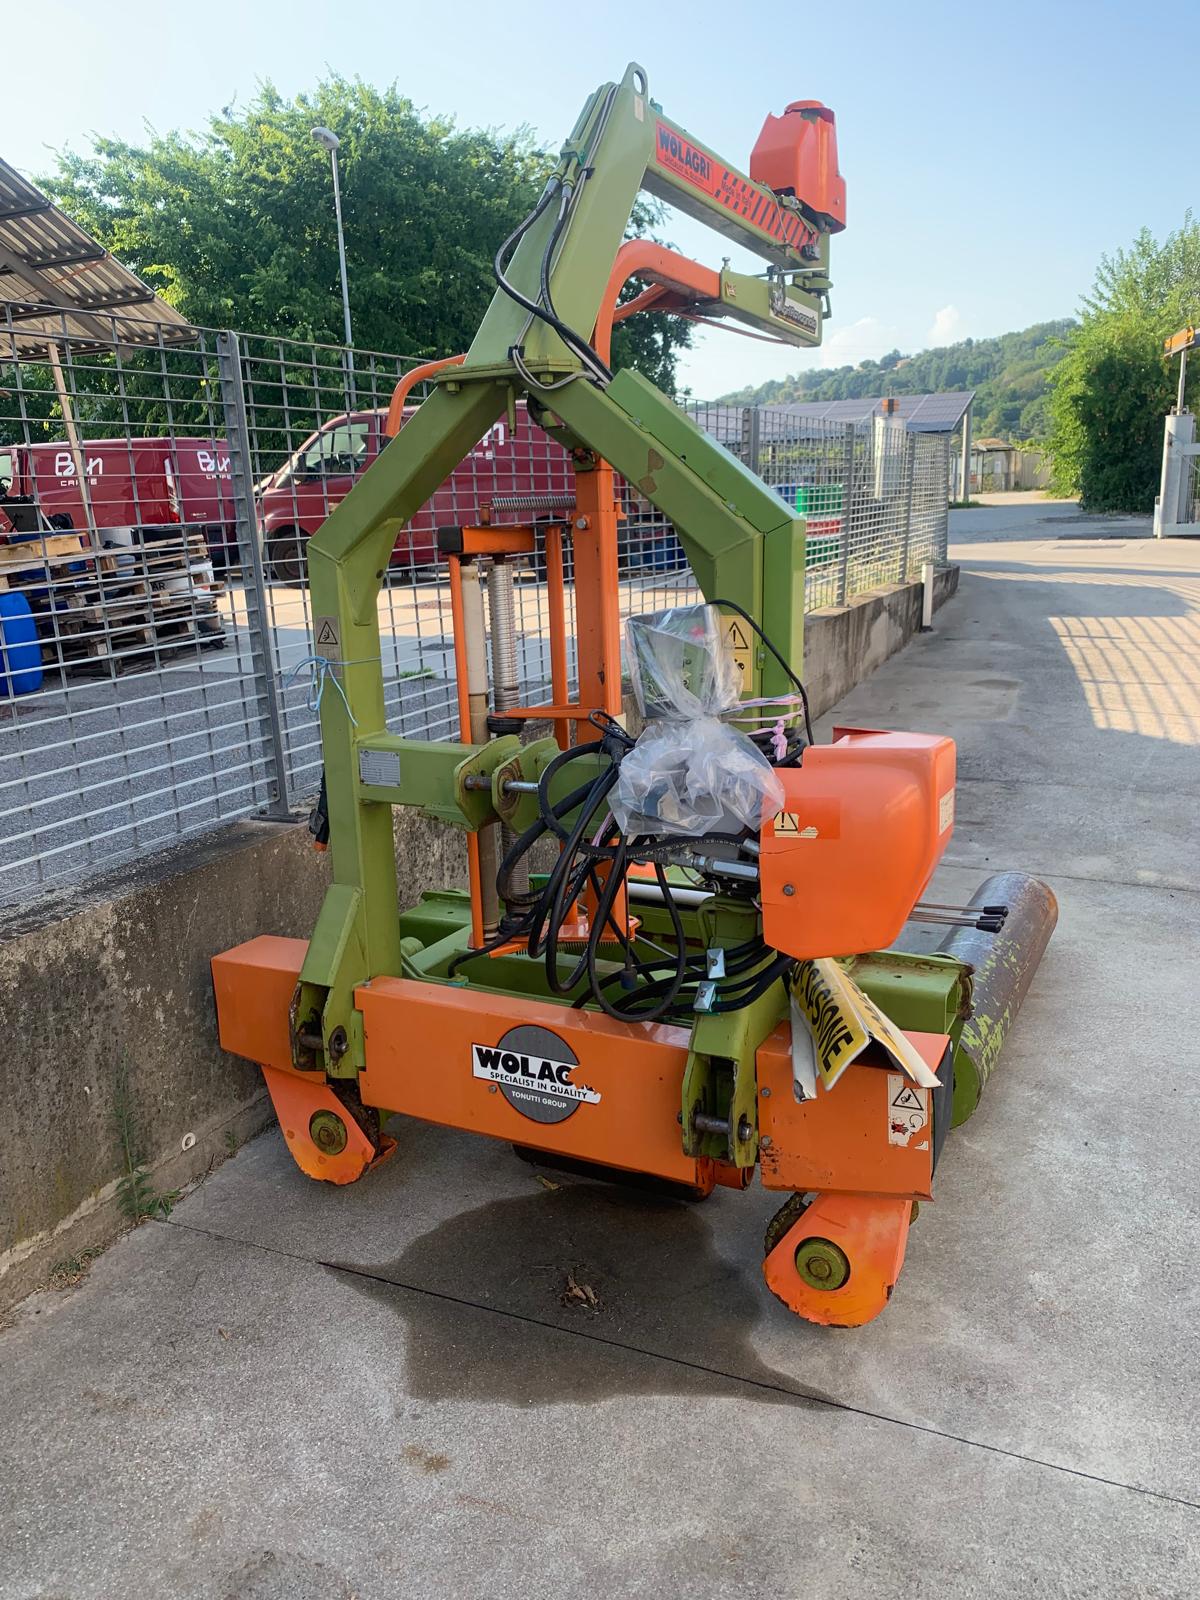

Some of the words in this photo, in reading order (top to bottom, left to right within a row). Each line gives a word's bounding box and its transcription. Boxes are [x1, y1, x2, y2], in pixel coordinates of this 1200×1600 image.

[659, 128, 710, 181] WOLAGRI
[55, 452, 103, 477] Bn
[475, 1046, 578, 1087] WOLAG
[490, 1071, 535, 1087] SPECIALIST
[537, 1082, 547, 1090] IN
[550, 1085, 588, 1099] QUALITY
[511, 1090, 541, 1103] TONUTTI
[541, 1098, 567, 1109] GROUP
